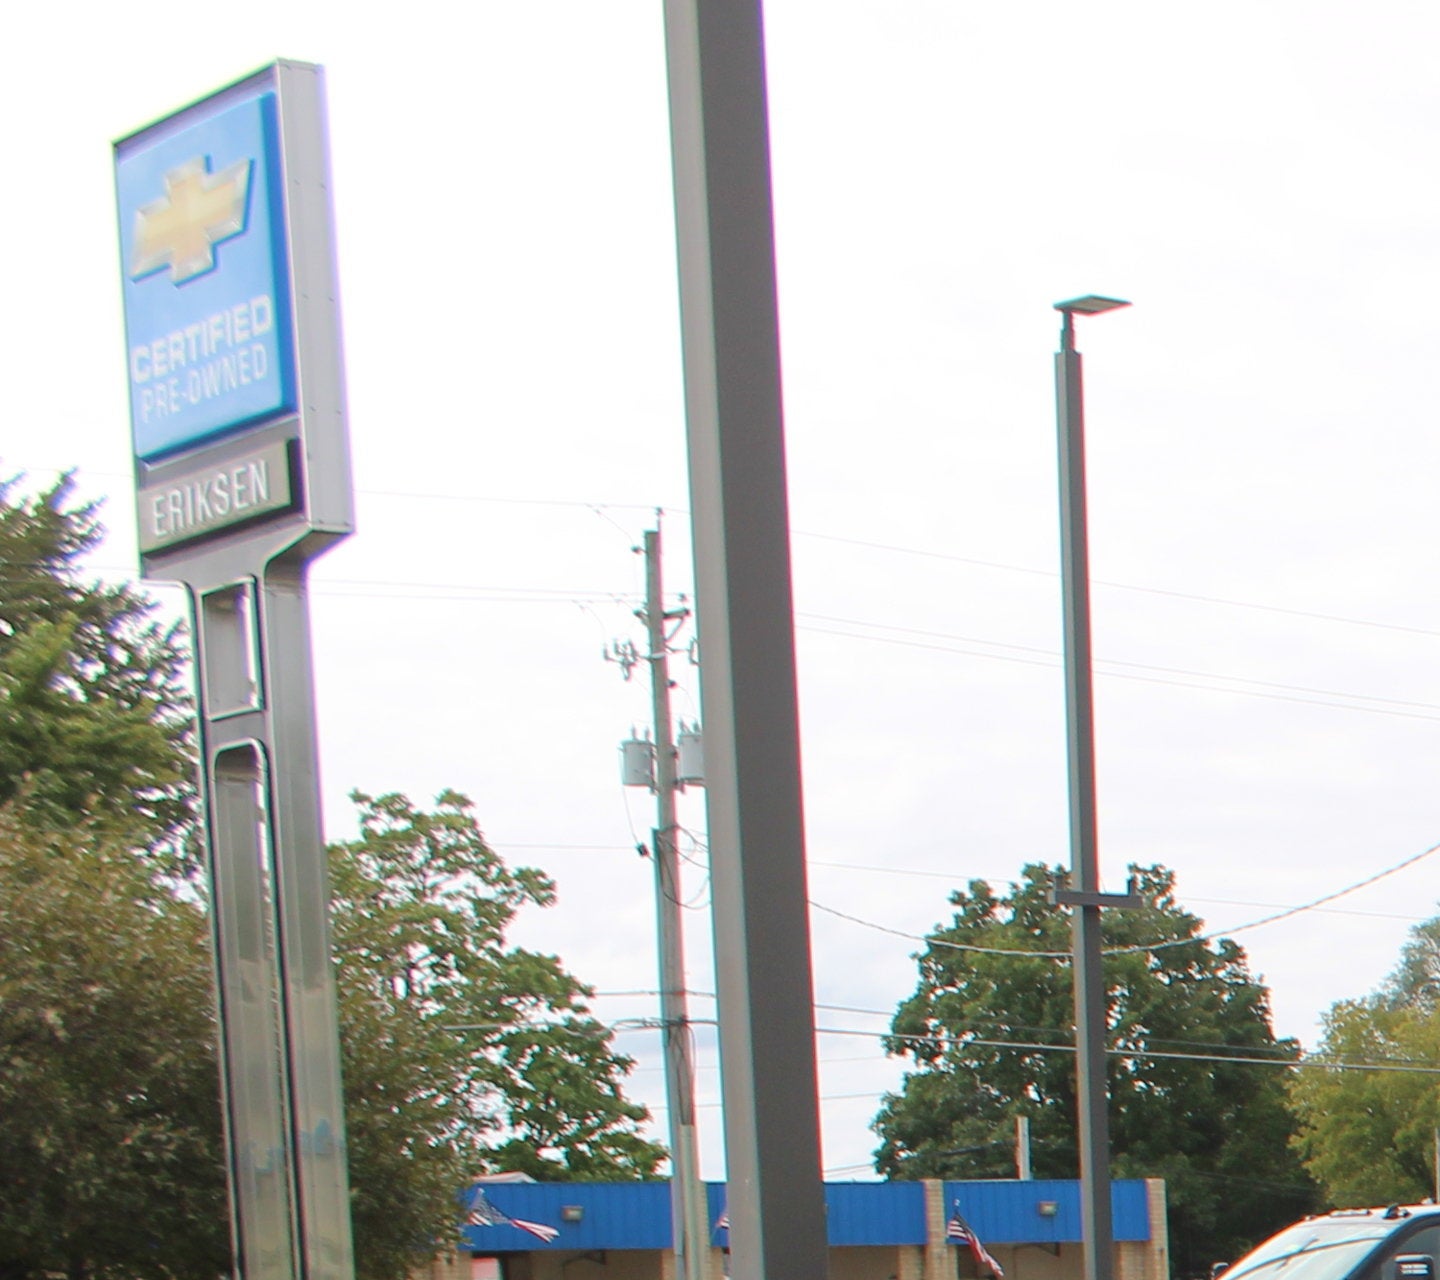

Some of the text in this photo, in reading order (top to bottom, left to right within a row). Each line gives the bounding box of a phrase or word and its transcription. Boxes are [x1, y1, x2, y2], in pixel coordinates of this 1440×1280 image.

[131, 293, 274, 385] CERTIFIED
[140, 342, 270, 422] PRE-OWNED
[153, 460, 268, 535] ERIKSEN
